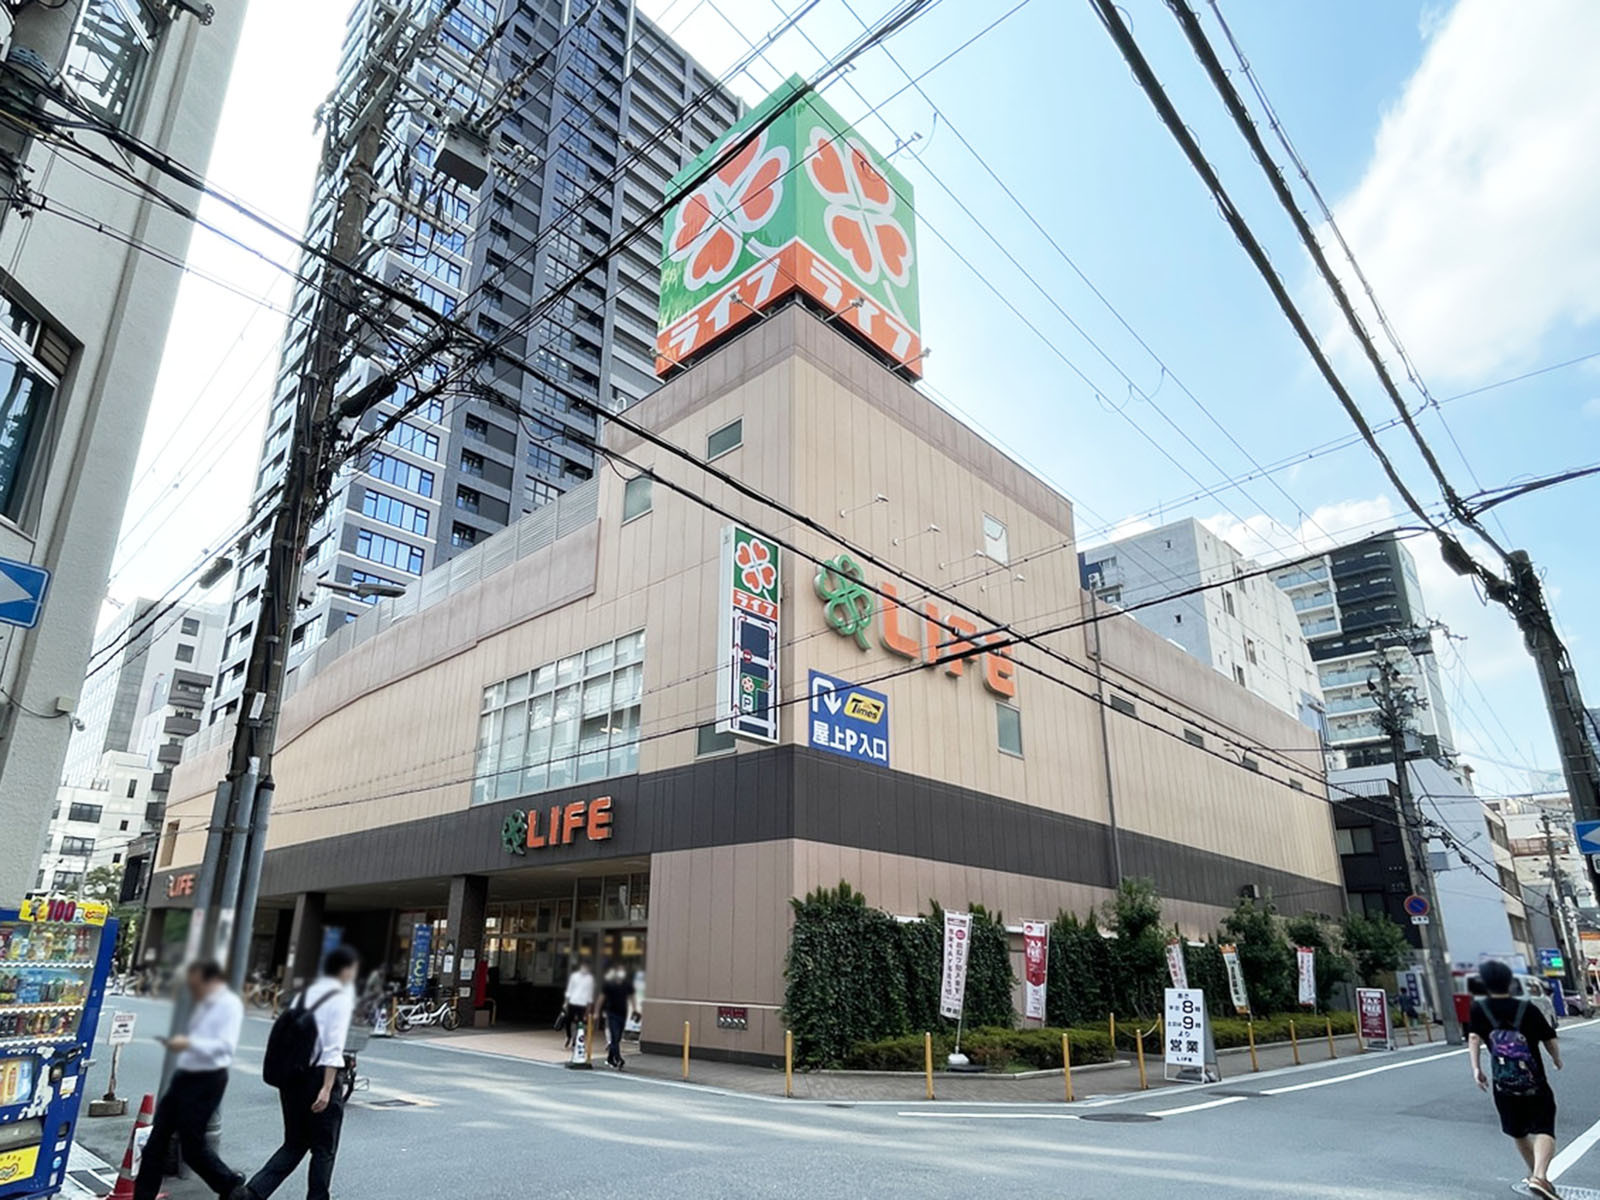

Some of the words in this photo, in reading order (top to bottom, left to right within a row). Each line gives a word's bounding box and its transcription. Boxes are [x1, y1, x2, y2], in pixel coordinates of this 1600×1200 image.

[669, 257, 781, 355] ライフ
[810, 256, 913, 358] ライフ
[735, 592, 775, 619] ライフ
[879, 581, 1016, 697] LIFE
[851, 698, 878, 719] Times
[812, 719, 887, 761] 屋上P入口
[526, 795, 614, 848] LIFE
[1170, 1039, 1198, 1053] 営業
